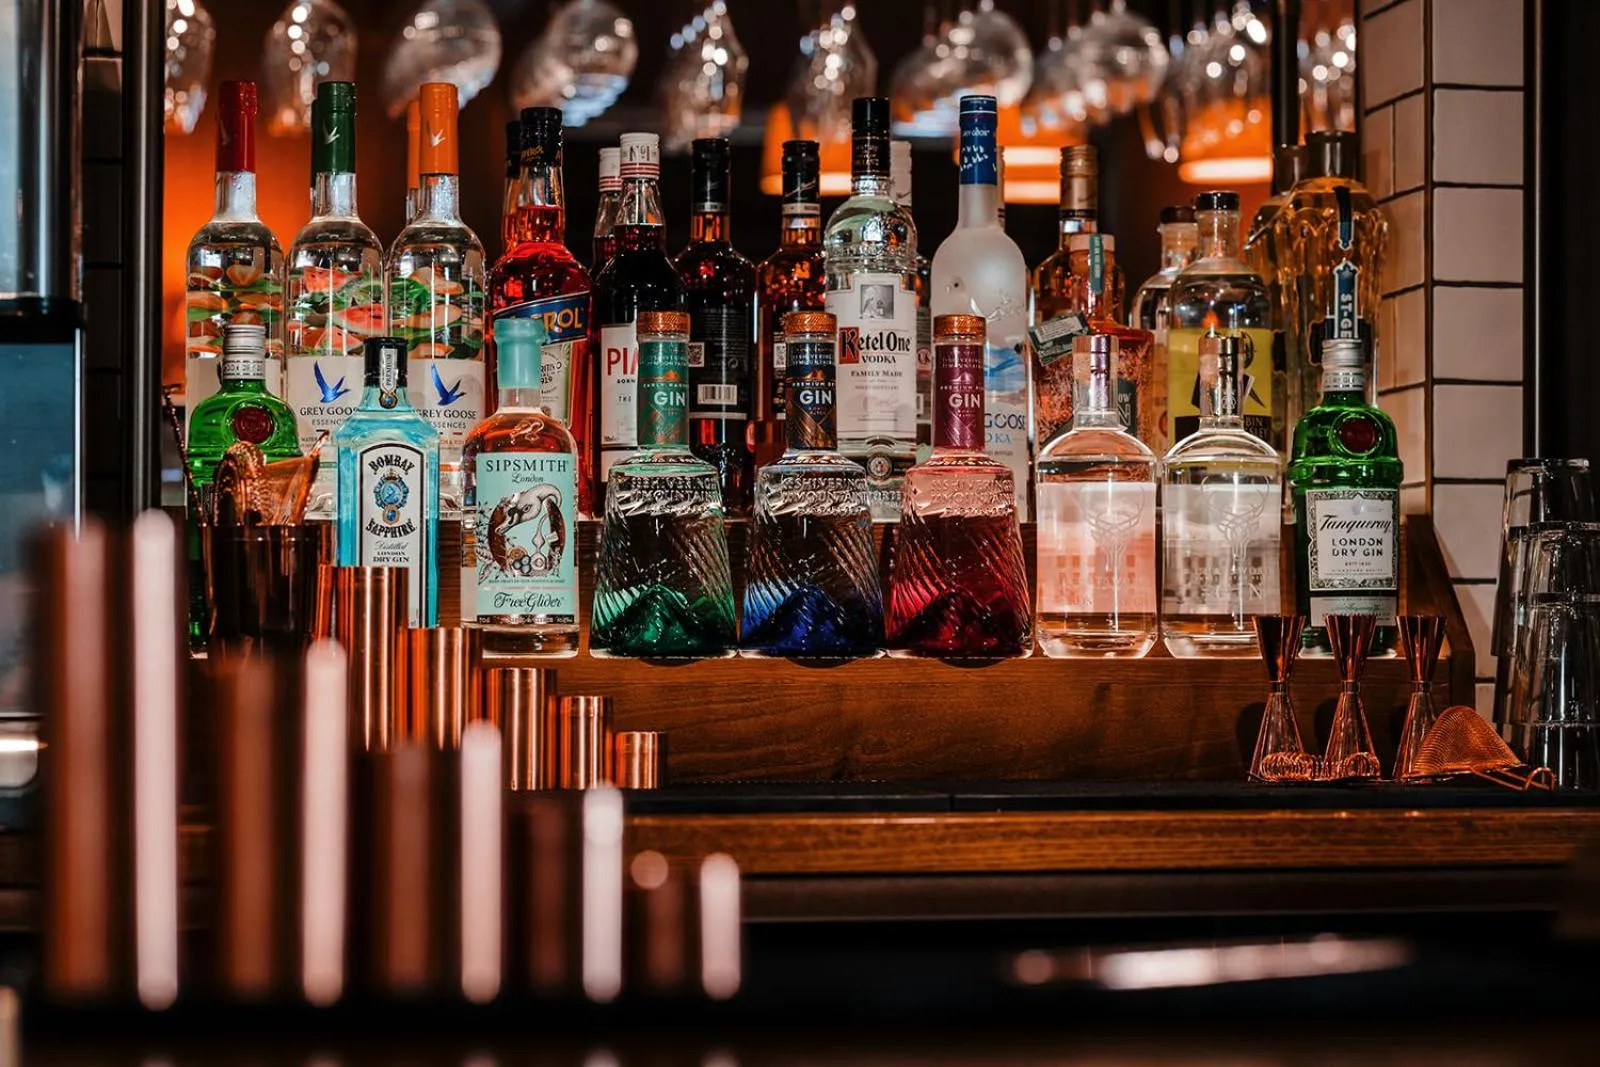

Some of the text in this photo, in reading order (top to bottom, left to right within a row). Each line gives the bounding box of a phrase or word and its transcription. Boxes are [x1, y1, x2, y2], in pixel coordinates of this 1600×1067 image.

[839, 328, 882, 359] Ketel
[886, 331, 911, 352] One
[861, 355, 896, 364] VODKA
[654, 391, 686, 407] GIN
[800, 390, 832, 405] GIN
[949, 393, 980, 409] GIN
[300, 406, 325, 416] GREY
[443, 409, 477, 419] GOOSE
[368, 454, 415, 473] BOMBAY
[486, 459, 567, 473] SIPSMITH
[511, 472, 544, 484] London
[366, 518, 417, 538] SAPPHIRE
[1320, 515, 1391, 533] Tanqueray
[1332, 537, 1383, 546] LONDON
[1332, 548, 1384, 557] DRY GIN
